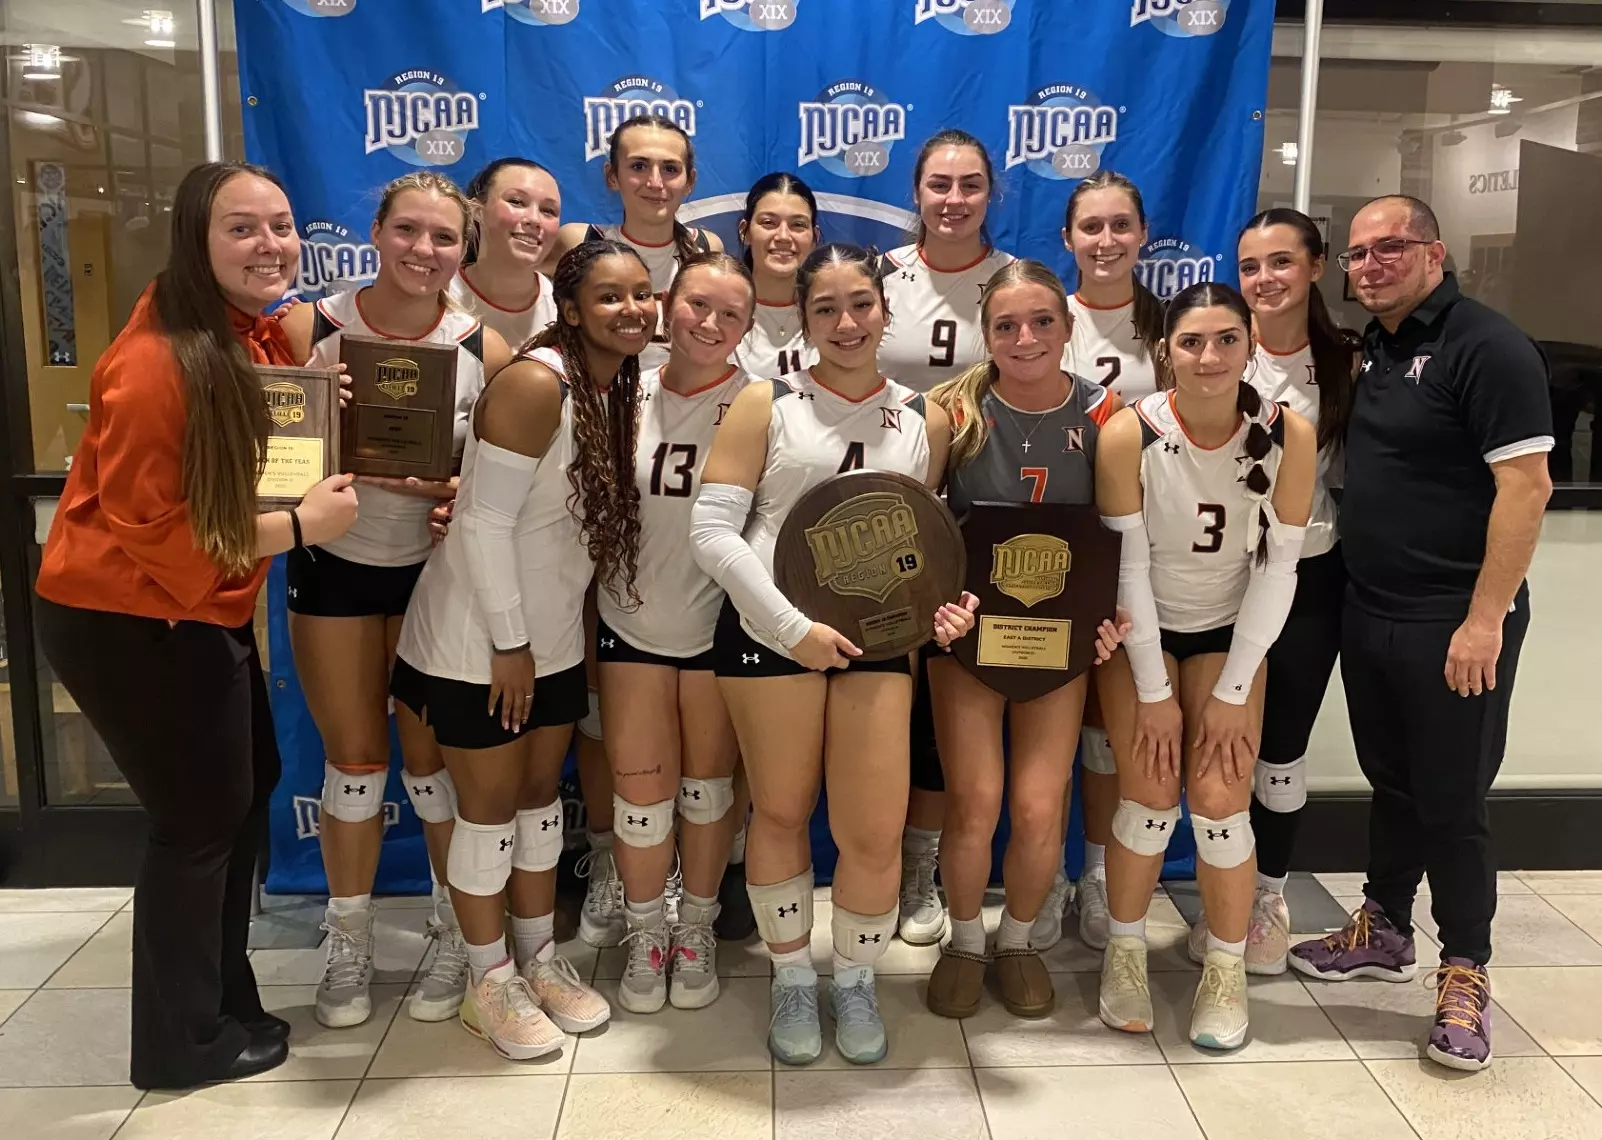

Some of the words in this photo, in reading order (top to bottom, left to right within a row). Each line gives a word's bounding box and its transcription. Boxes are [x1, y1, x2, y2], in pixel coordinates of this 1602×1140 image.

[759, 4, 788, 20] XIX
[972, 8, 1002, 24] XIX
[1187, 10, 1218, 26] XIX
[394, 70, 430, 85] REGION
[432, 74, 445, 86] 19
[613, 77, 649, 92] REGION
[651, 81, 663, 93] 19
[827, 82, 862, 97] REGION
[863, 85, 875, 97] 19
[1037, 85, 1073, 100] REGION
[1075, 88, 1087, 100] 19
[365, 90, 478, 152] NJCAA
[799, 102, 904, 165] NJCAA
[426, 140, 456, 156] XIX
[1006, 106, 1116, 169] NJCAA
[854, 150, 881, 167] XIX
[1061, 153, 1092, 169] XIX
[335, 225, 348, 237] 19
[1147, 238, 1177, 253] REGION
[928, 319, 957, 367] 9
[1095, 356, 1121, 388] 2
[292, 410, 302, 420] 19
[880, 406, 903, 434] N
[1062, 426, 1086, 458] N
[649, 441, 698, 498] 13
[836, 441, 865, 473] 4
[1020, 466, 1048, 504] 7
[1191, 502, 1227, 553] 3
[808, 507, 915, 583] NJCAA
[842, 564, 888, 585] REGION
[895, 552, 917, 573] 19
[994, 547, 1069, 580] NJCAA
